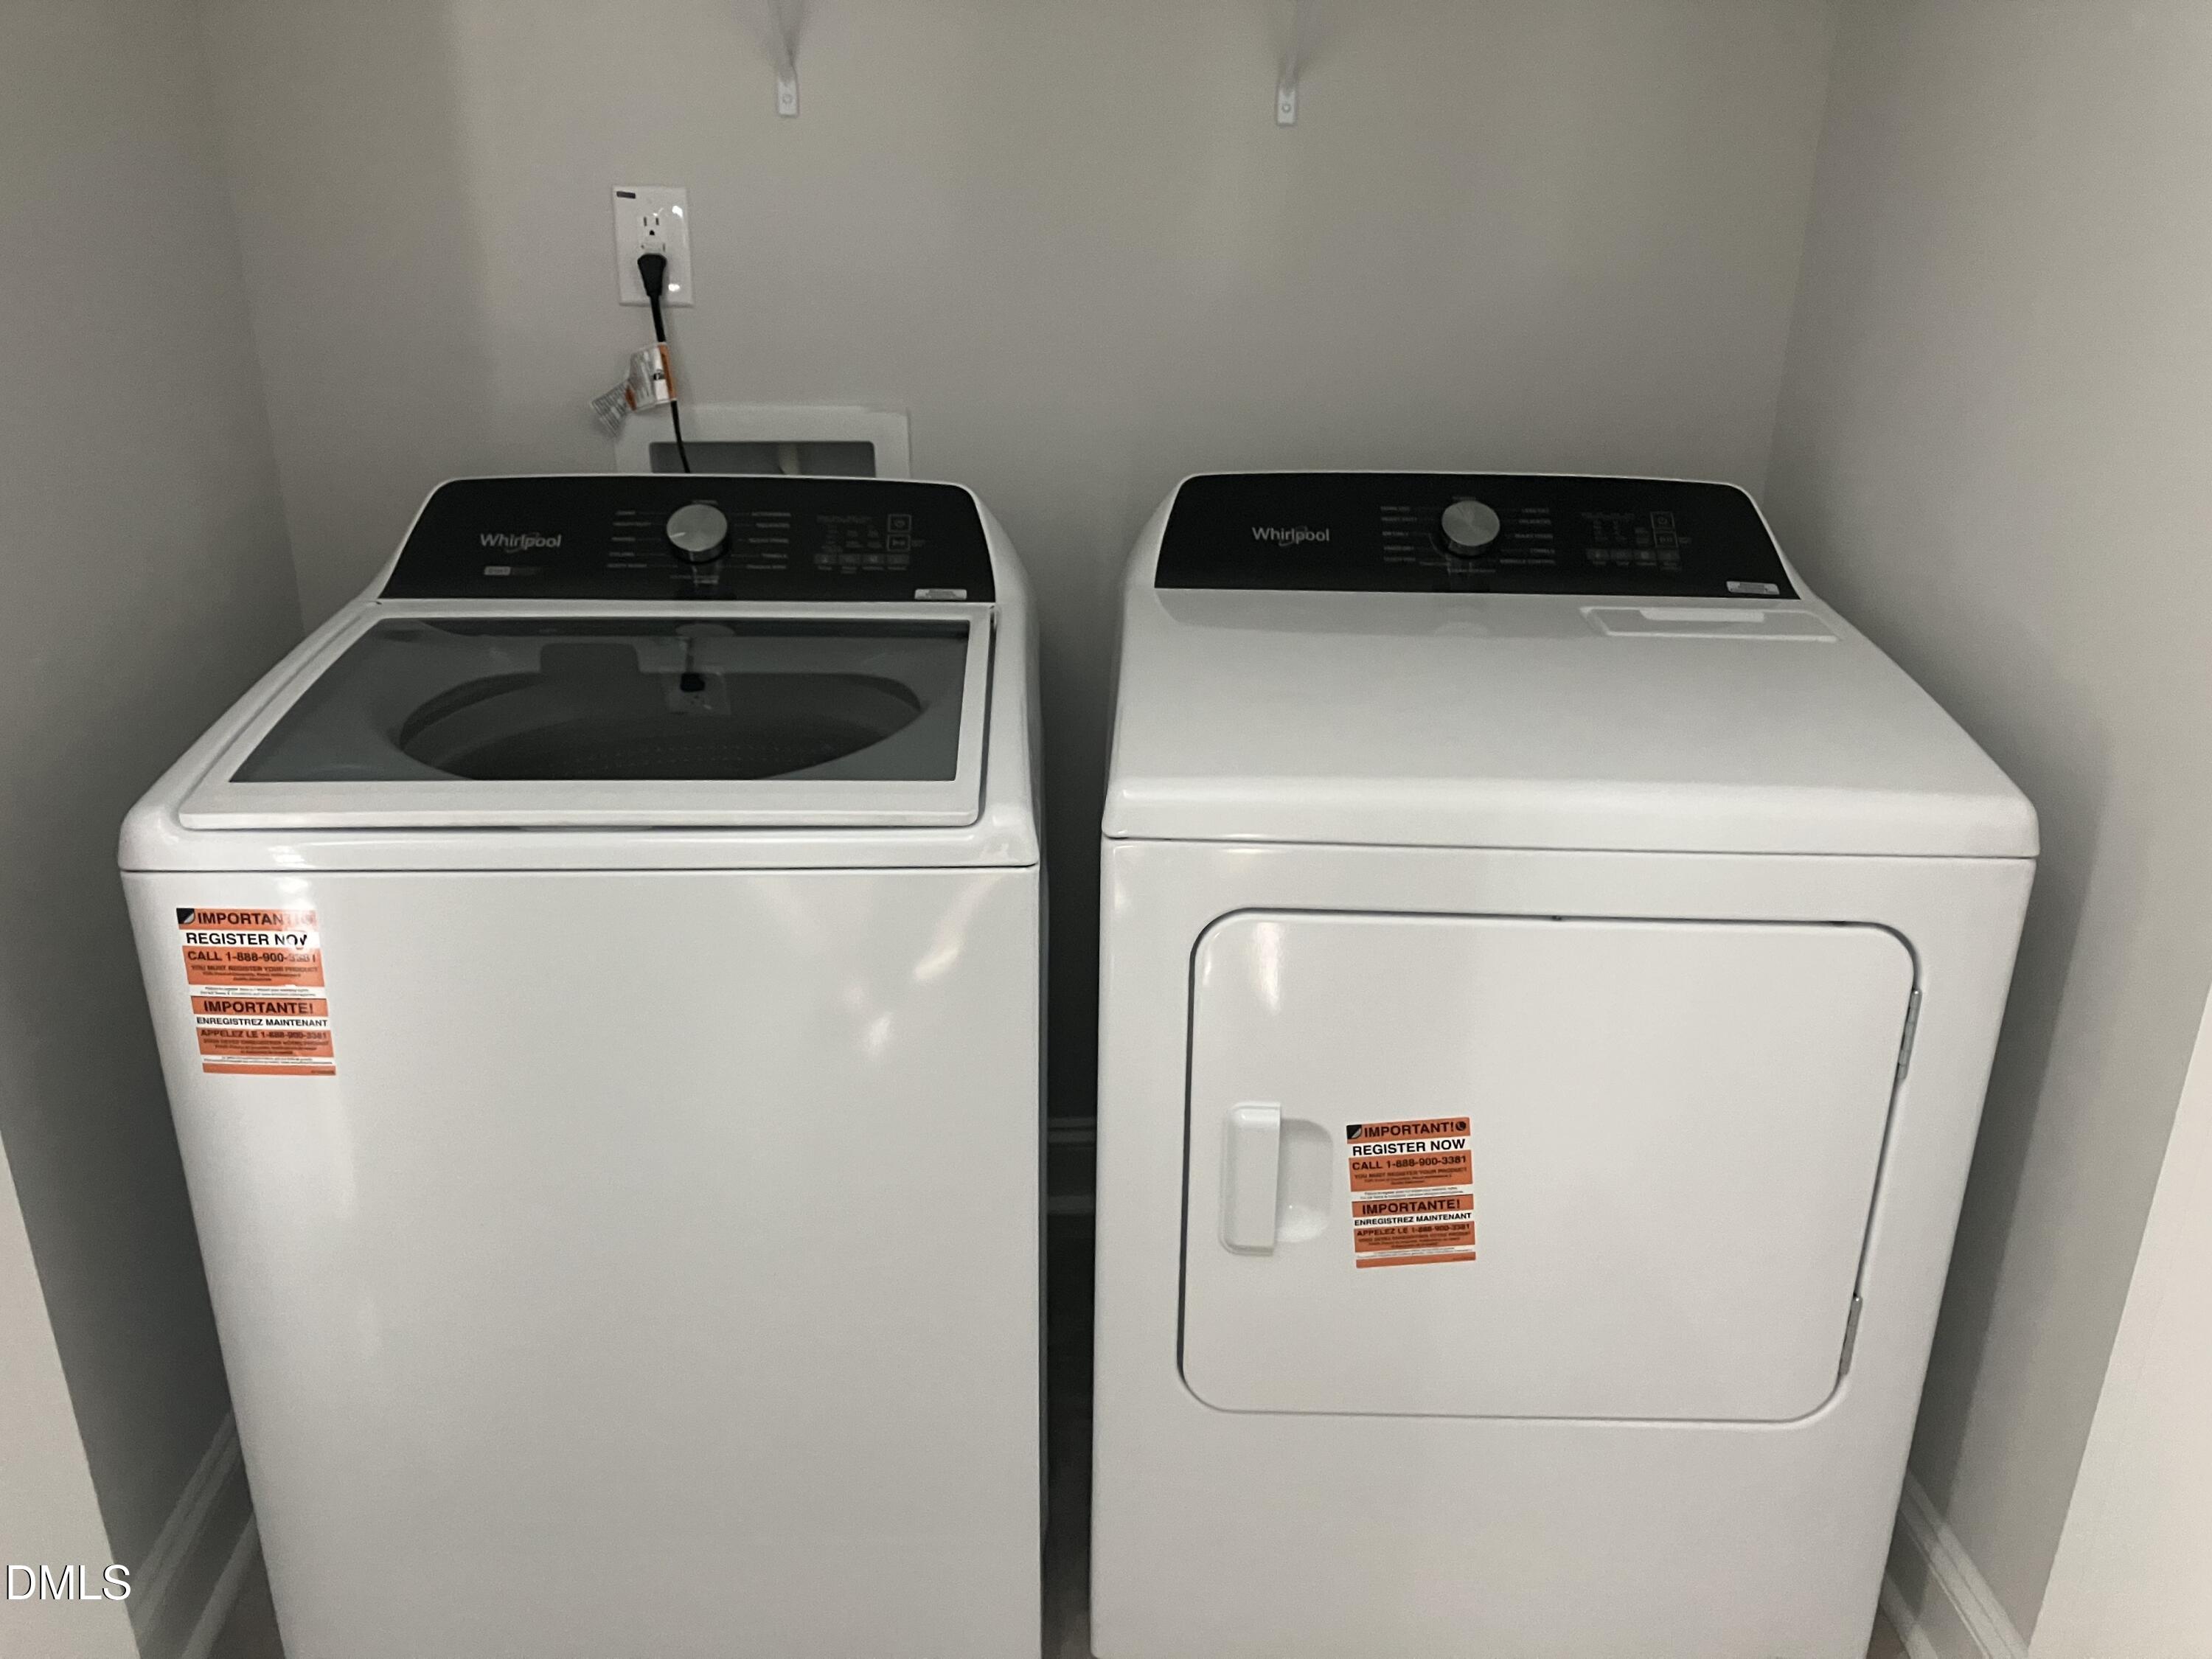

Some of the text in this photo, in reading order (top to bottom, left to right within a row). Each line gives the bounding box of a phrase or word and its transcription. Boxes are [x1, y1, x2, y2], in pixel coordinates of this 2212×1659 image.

[480, 533, 562, 551] Whirlpool
[1252, 526, 1330, 545] Whirlpool
[186, 932, 269, 946] REGISTER
[188, 950, 222, 961] CALL
[204, 1000, 313, 1014] IMPORTANTE!
[196, 1017, 327, 1027] ENREGISTREZ MAINTENANT
[201, 1029, 243, 1038] APPELEZ
[246, 1030, 258, 1038] LE
[1365, 1121, 1454, 1138] IMPORTANT!
[1352, 1138, 1466, 1156] REGISTER NOW
[1352, 1155, 1467, 1171] CALL 1-888-900-3381
[1362, 1199, 1460, 1214] IMPORTANTE!
[1354, 1212, 1472, 1226] ENREGISTREZ MAINTENANT
[1356, 1228, 1395, 1237] APPELEZ
